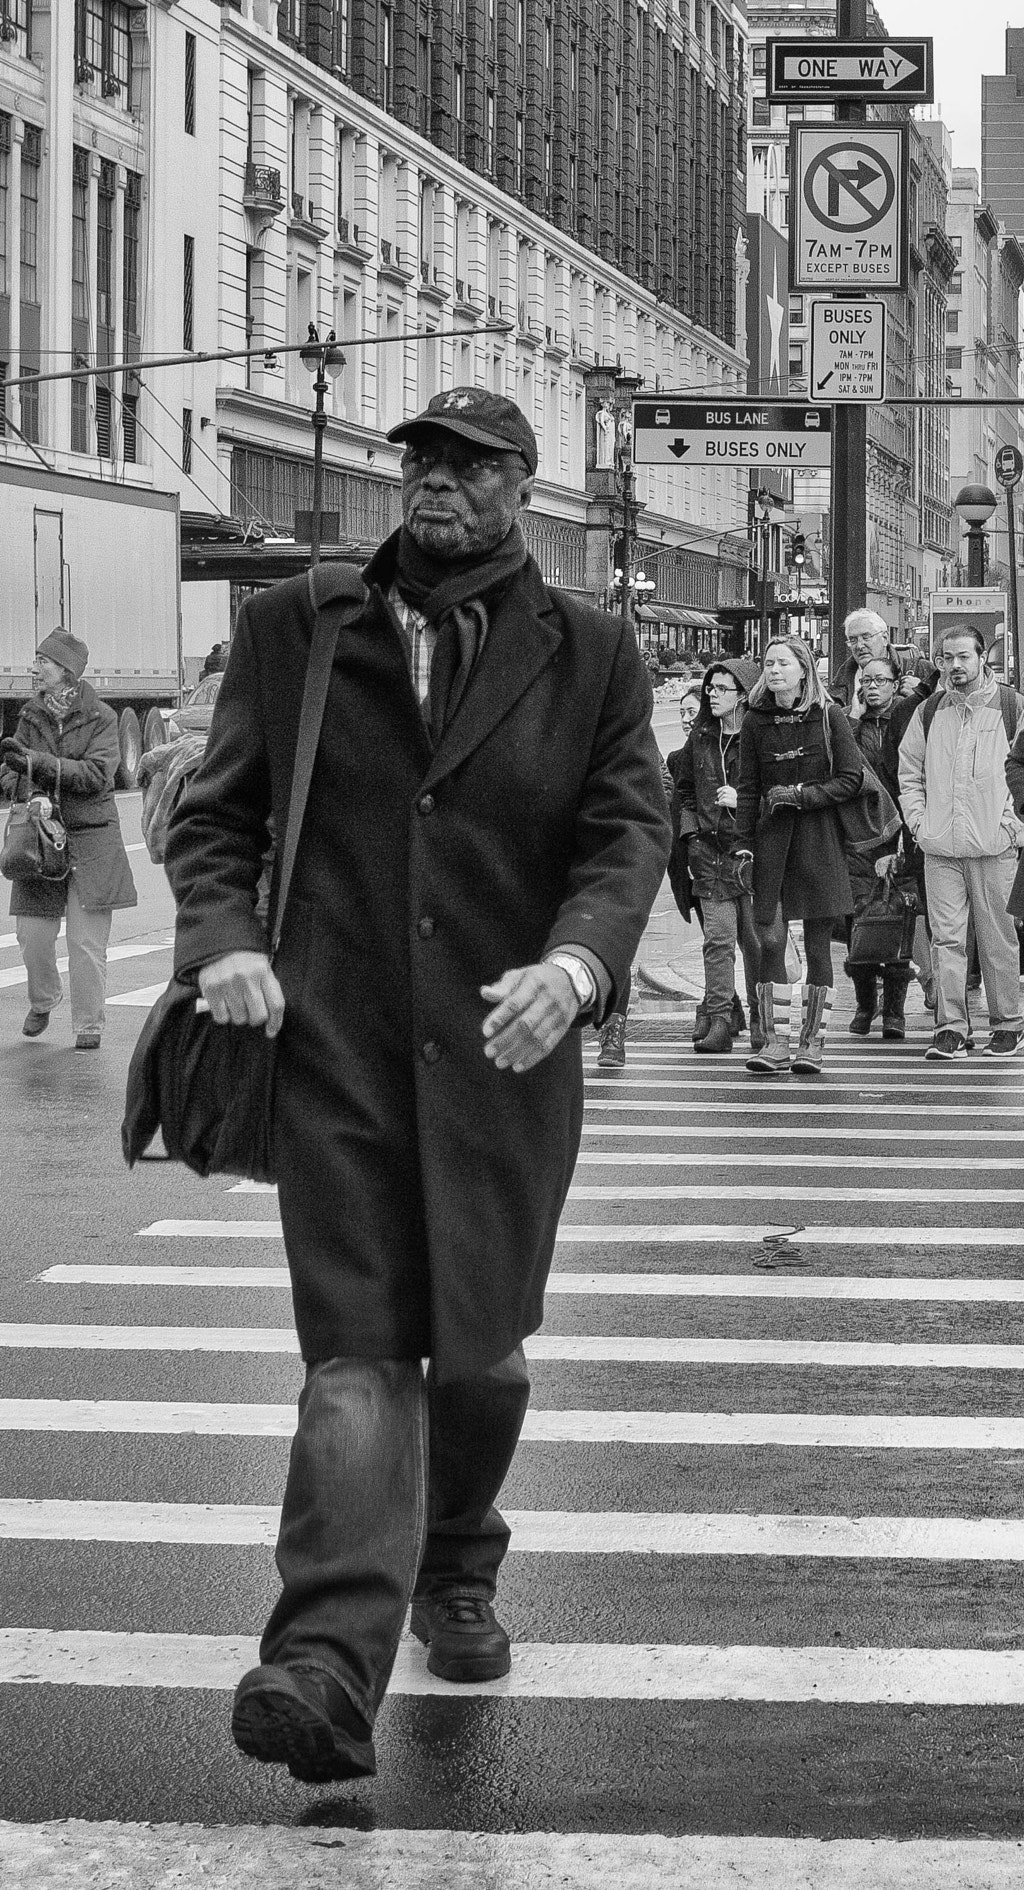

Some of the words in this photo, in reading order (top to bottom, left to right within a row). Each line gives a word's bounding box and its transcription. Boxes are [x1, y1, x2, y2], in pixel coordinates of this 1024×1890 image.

[798, 59, 838, 77] ONE
[858, 59, 904, 77] WAY
[806, 263, 849, 273] EXCEPT
[853, 263, 890, 273] BUSES
[824, 309, 872, 323] BUSES
[829, 330, 866, 344] ONLY
[839, 350, 853, 359] 7AM
[859, 350, 874, 359] 7PM
[834, 361, 850, 370] MON
[867, 361, 878, 370] FRI
[839, 373, 852, 382] 1PM
[858, 373, 873, 382] 7PM
[838, 384, 850, 393] SAT
[852, 384, 857, 393] &
[859, 384, 874, 393] SUN
[706, 411, 731, 424] BUS
[735, 412, 769, 425] LANE
[705, 441, 759, 457] BUSES
[766, 442, 807, 458] ONLY
[946, 597, 991, 605] Phone
